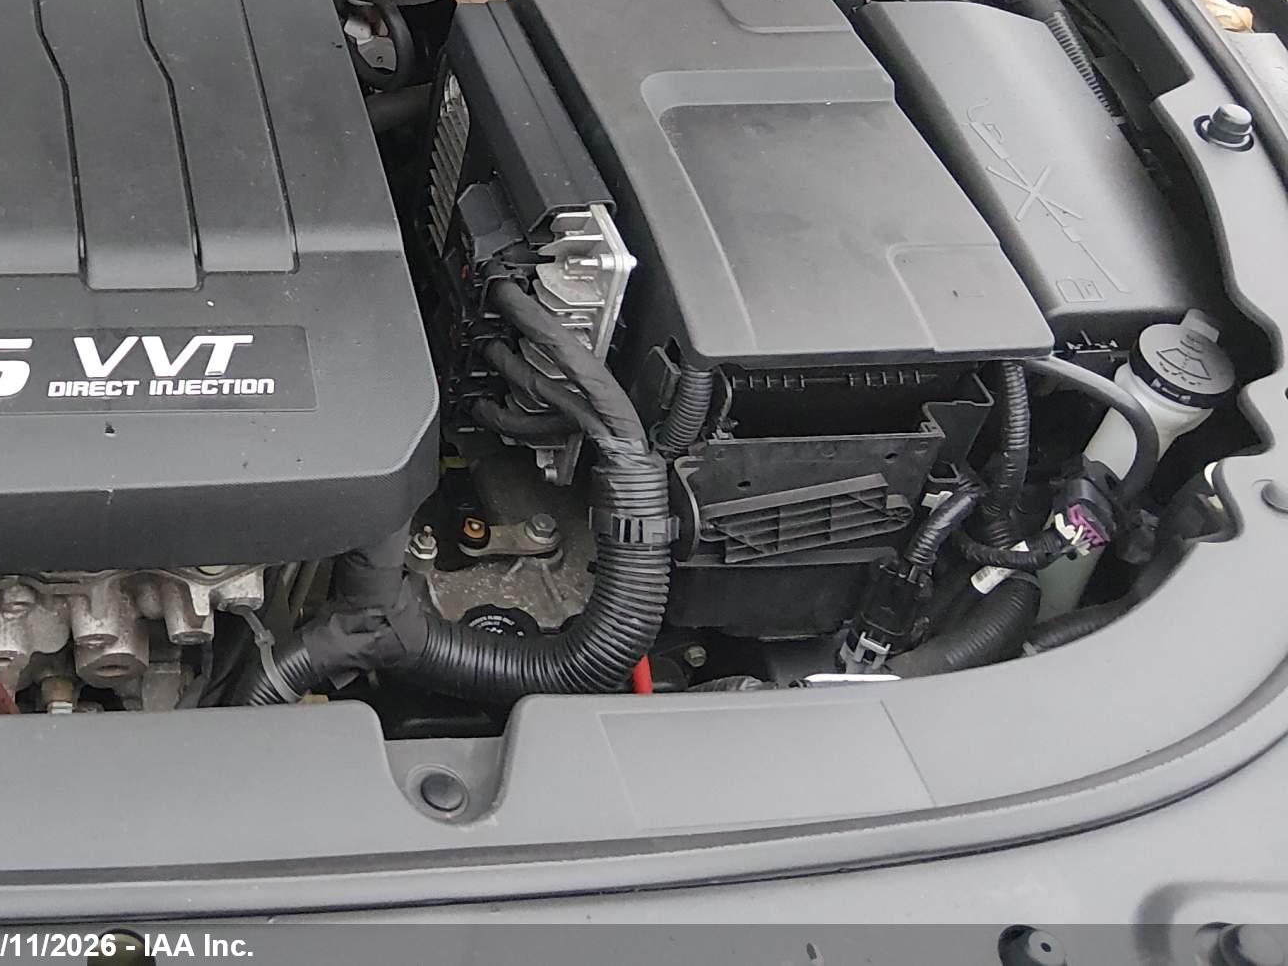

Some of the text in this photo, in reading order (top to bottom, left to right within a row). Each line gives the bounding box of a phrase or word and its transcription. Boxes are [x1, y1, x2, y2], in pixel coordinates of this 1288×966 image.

[72, 334, 254, 378] VVT
[47, 377, 275, 398] DIRECT INJECTION
